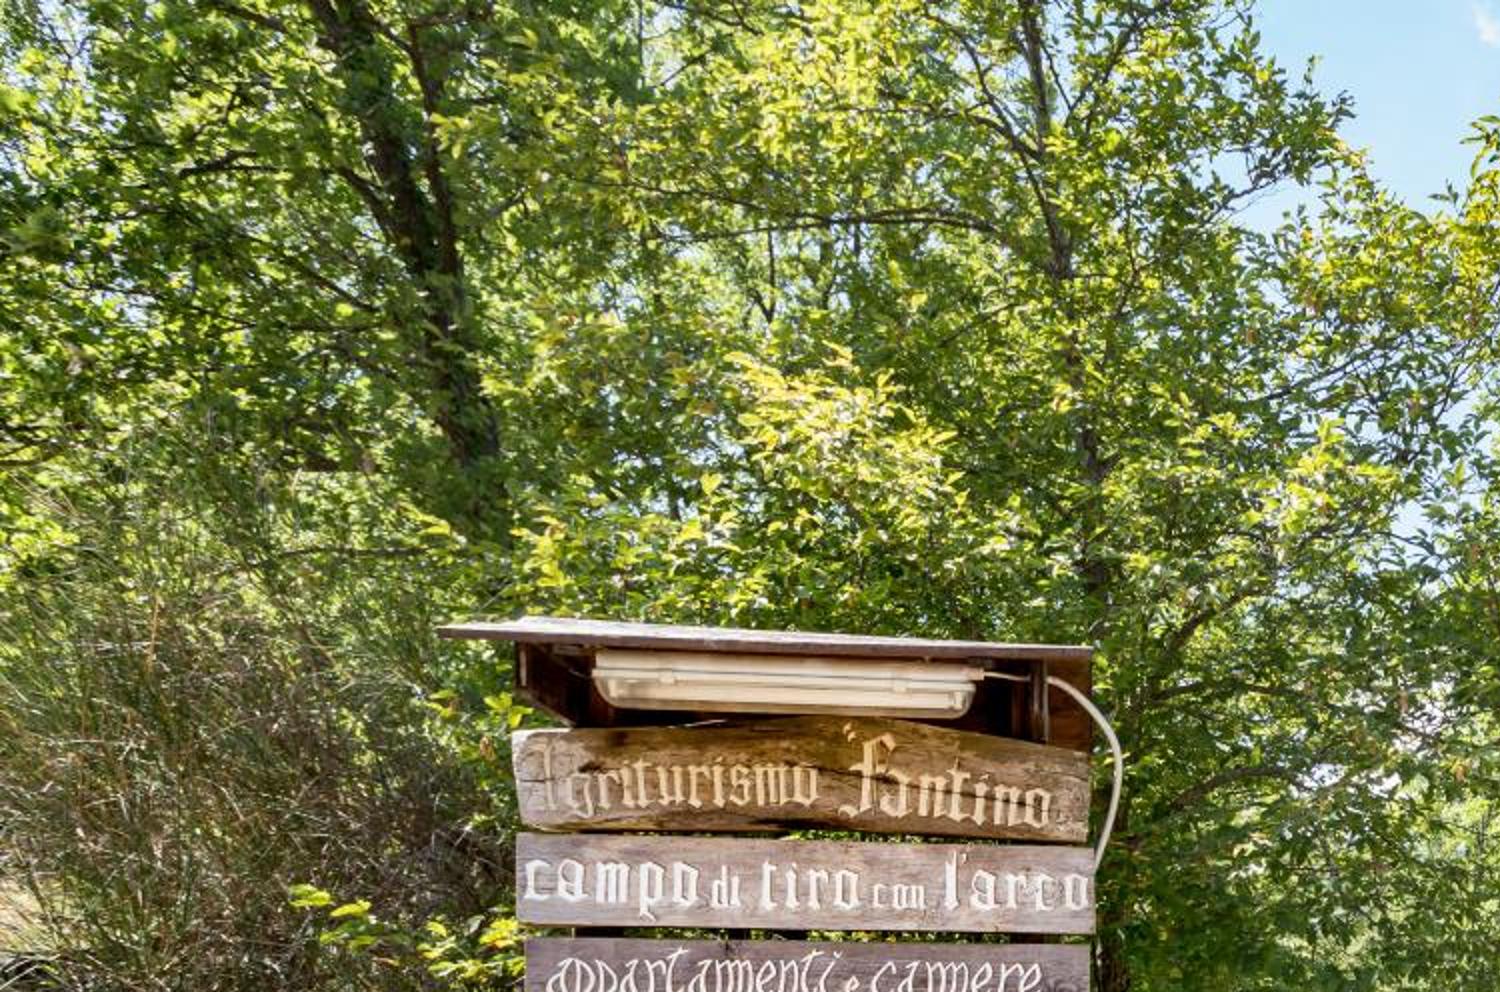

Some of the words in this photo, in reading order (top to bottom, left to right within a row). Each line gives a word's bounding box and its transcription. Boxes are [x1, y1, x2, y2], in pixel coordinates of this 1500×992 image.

[838, 724, 1051, 829] Fantino
[523, 856, 701, 922] campo
[711, 867, 741, 908] di
[760, 857, 861, 912] tiro
[873, 880, 928, 911] con
[943, 850, 1090, 912] l'arco
